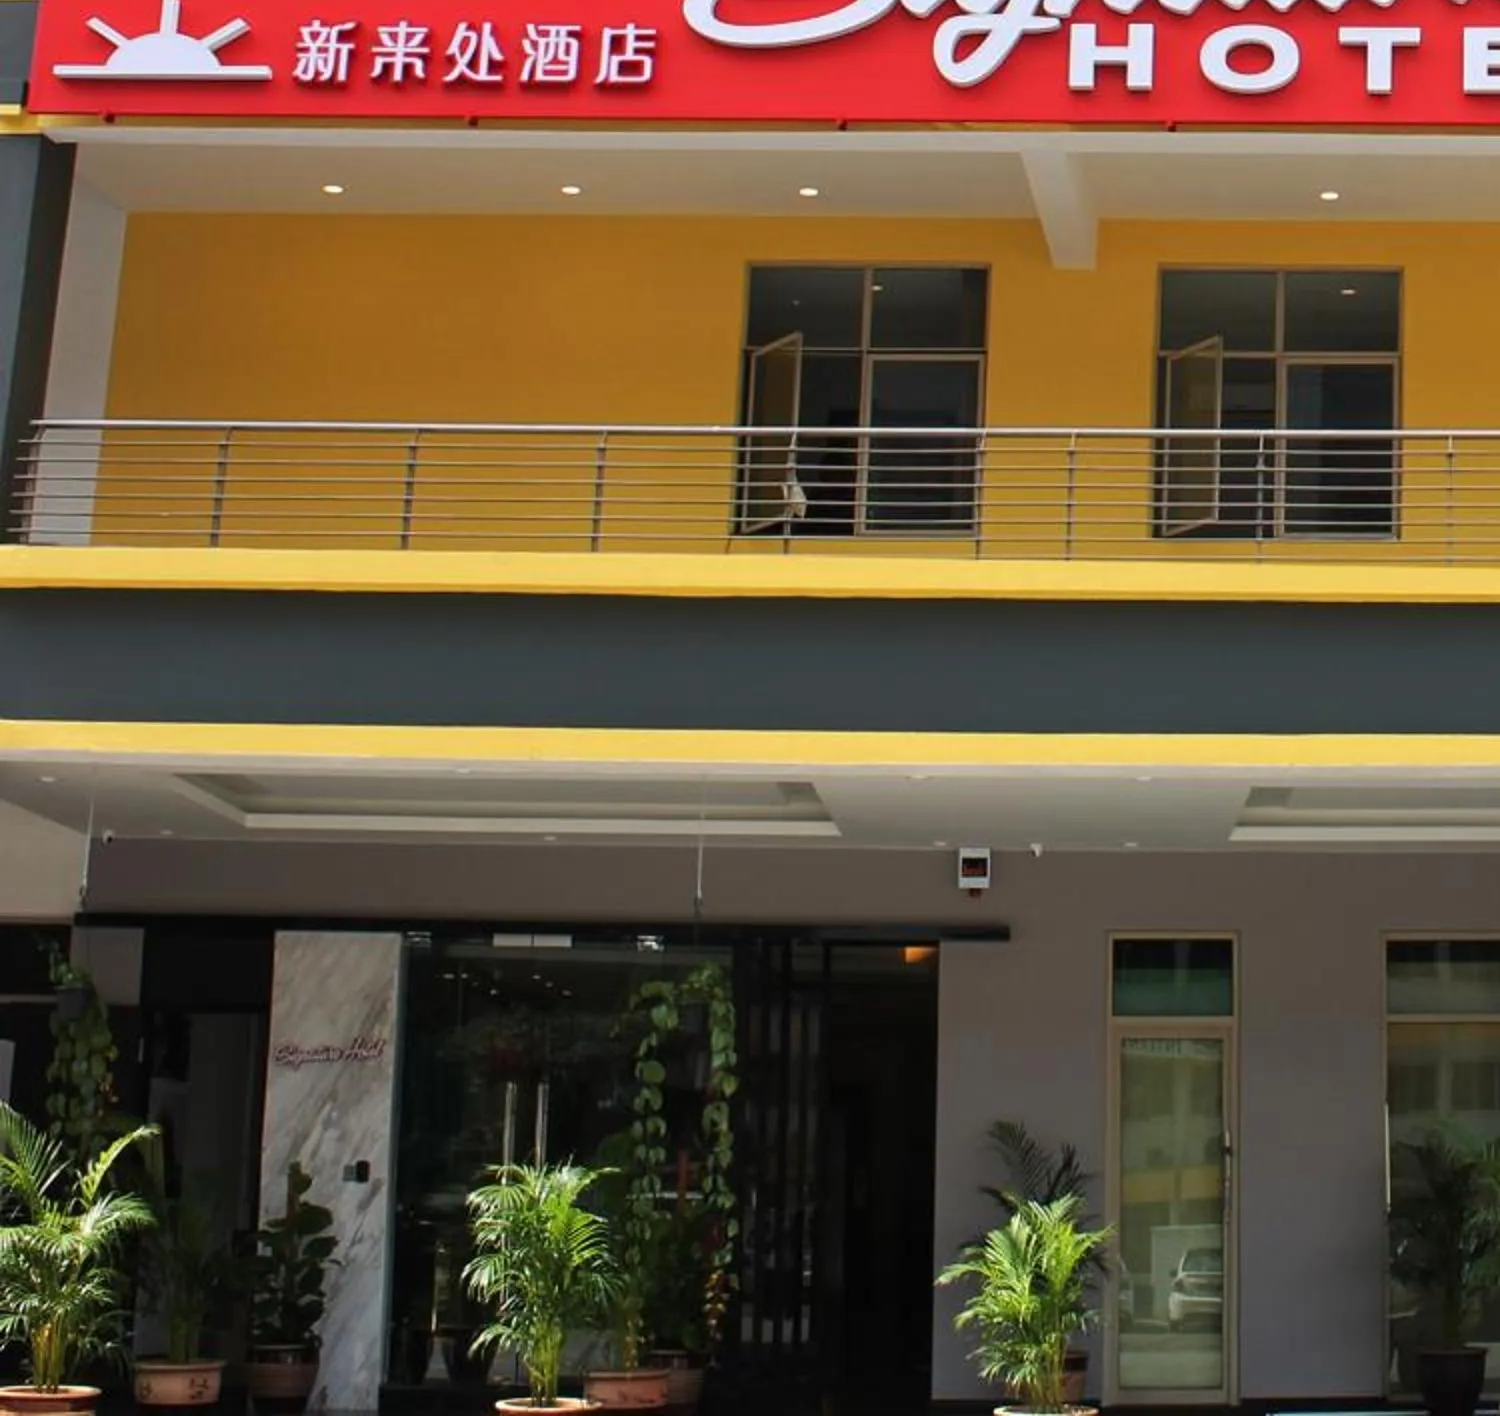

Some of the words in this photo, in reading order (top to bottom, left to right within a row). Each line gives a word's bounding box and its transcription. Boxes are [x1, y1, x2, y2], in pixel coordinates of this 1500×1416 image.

[292, 18, 658, 85] 新来处酒店
